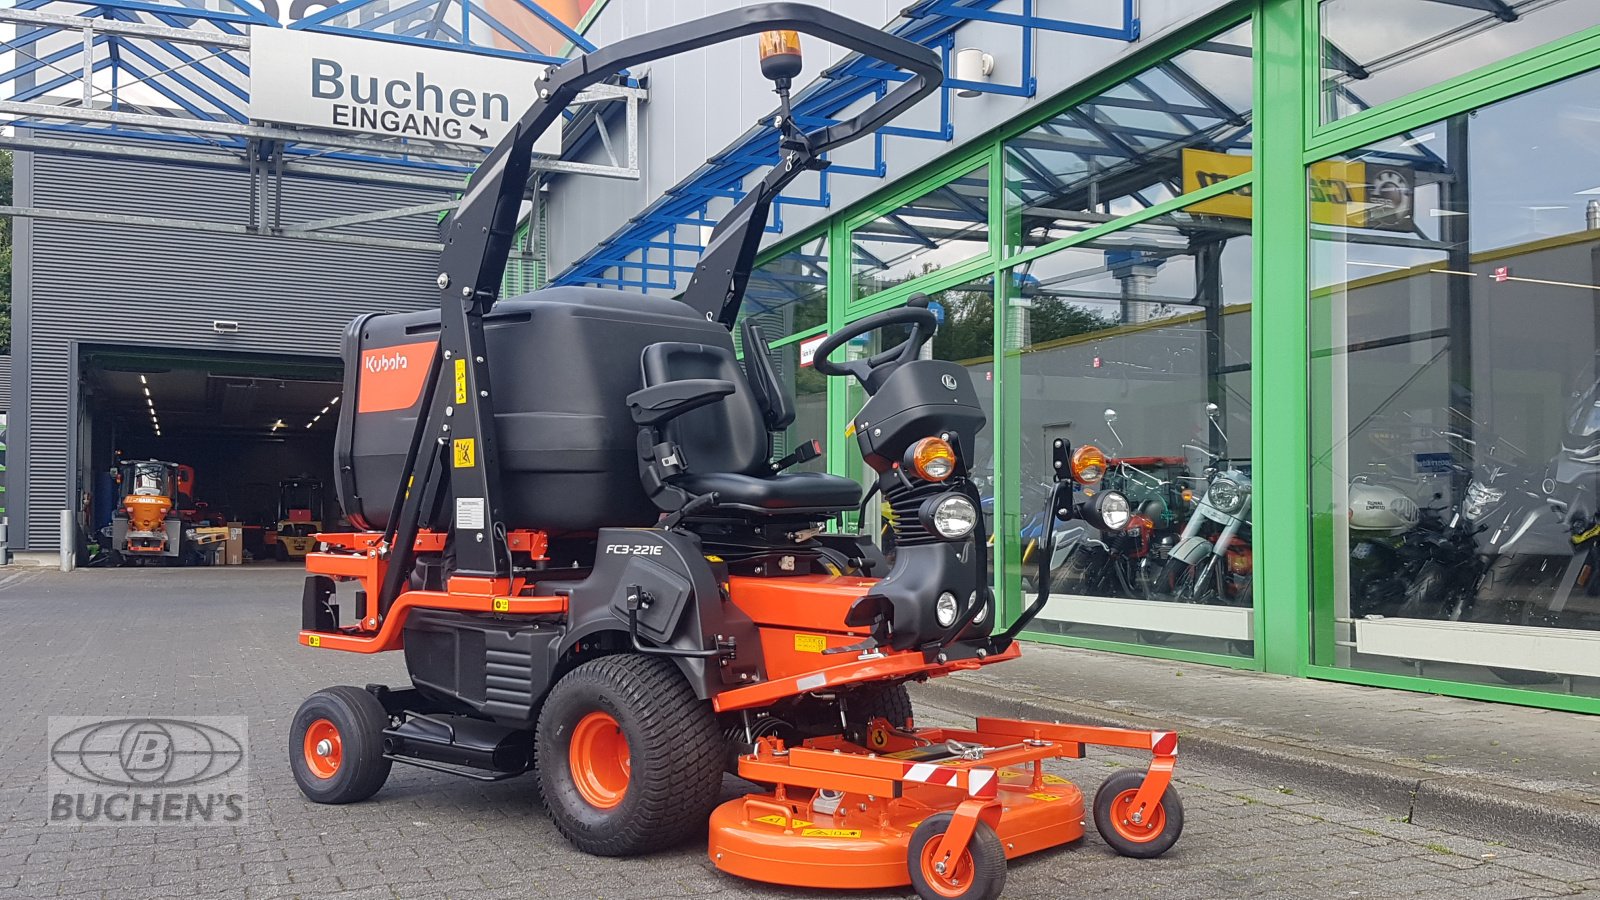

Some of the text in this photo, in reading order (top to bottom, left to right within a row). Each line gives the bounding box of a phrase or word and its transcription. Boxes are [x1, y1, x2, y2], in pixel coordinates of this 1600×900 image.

[312, 58, 509, 122] Buchen
[333, 104, 462, 139] EINGANG
[365, 352, 408, 372] Kubota
[606, 544, 663, 555] FC3-221E
